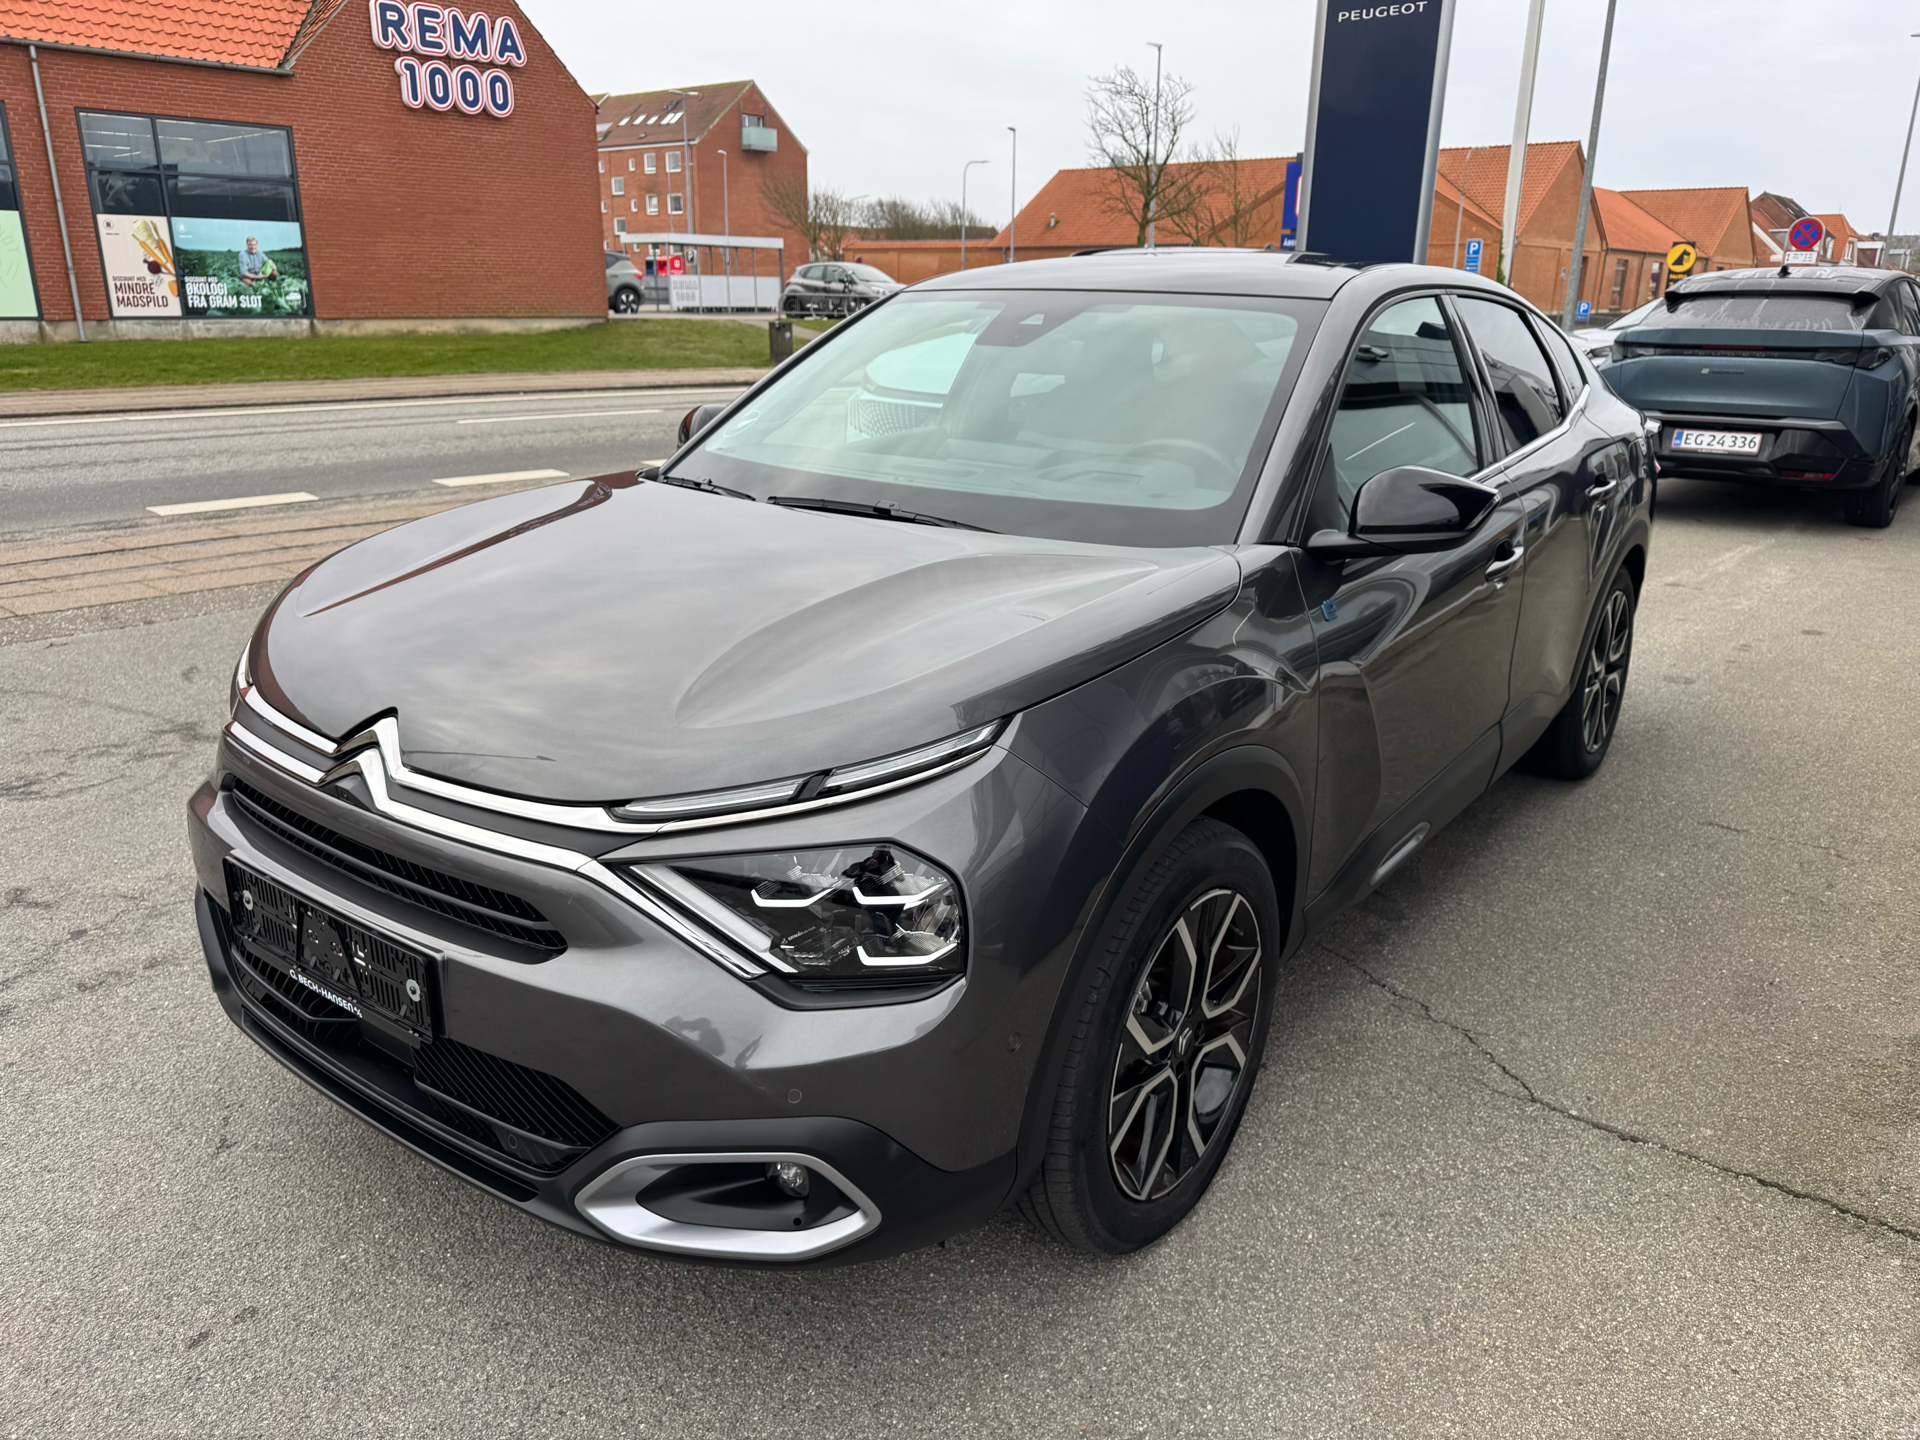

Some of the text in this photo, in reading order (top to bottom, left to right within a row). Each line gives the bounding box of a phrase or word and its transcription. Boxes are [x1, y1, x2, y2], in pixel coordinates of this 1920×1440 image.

[1337, 1, 1428, 23] PEUGEOT
[371, 0, 527, 67] REMA
[394, 56, 515, 118] 1000
[1469, 242, 1479, 255] P
[114, 282, 156, 295] MINDRE
[185, 282, 228, 296] ØKOLOGI
[116, 295, 169, 308] MADSPILD
[187, 294, 263, 309] FRA GRAM SLOT
[1580, 302, 1589, 314] P
[298, 974, 354, 1013] BECH-HANSEN
